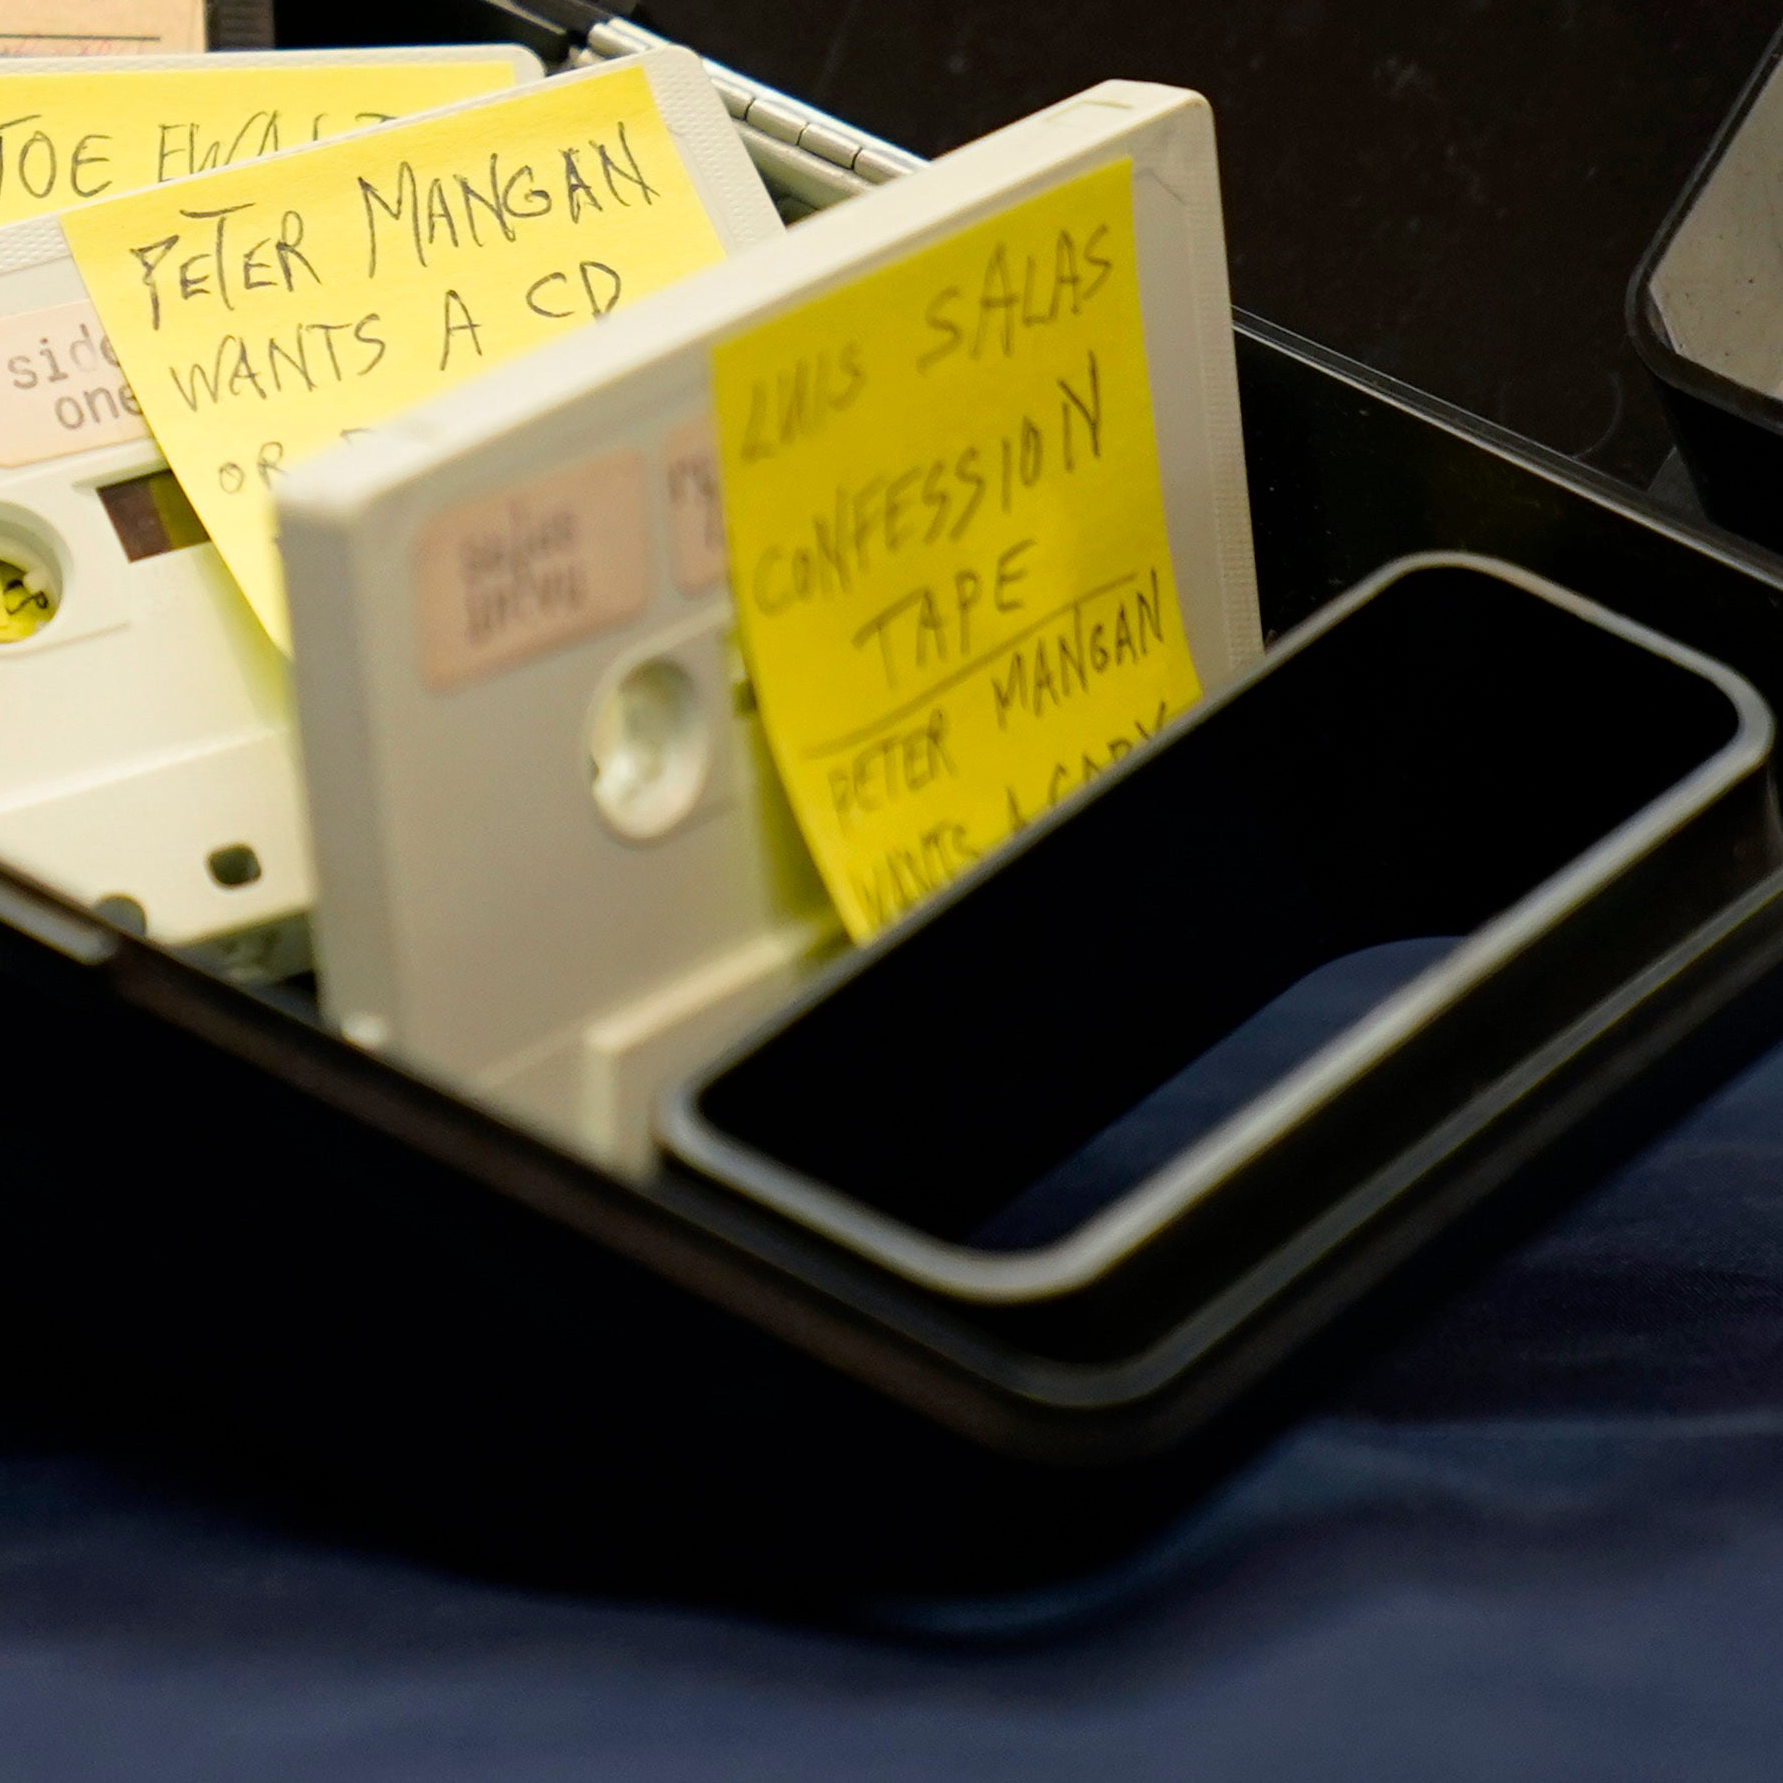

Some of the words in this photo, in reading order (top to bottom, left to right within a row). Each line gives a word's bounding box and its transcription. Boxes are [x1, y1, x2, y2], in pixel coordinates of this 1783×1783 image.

[130, 202, 321, 331] PETER
[357, 121, 662, 278] MANGAN
[54, 383, 144, 430] one
[169, 313, 386, 413] WANTS
[438, 289, 483, 372] A
[524, 261, 623, 322] CD
[740, 341, 867, 464] LUIS
[915, 223, 1114, 376] SALAS
[218, 440, 288, 495] OR
[751, 348, 1103, 617] CONFESSION
[828, 709, 959, 839] PETER
[990, 567, 1165, 733] MANGAN
[851, 539, 1038, 691] TAPE
